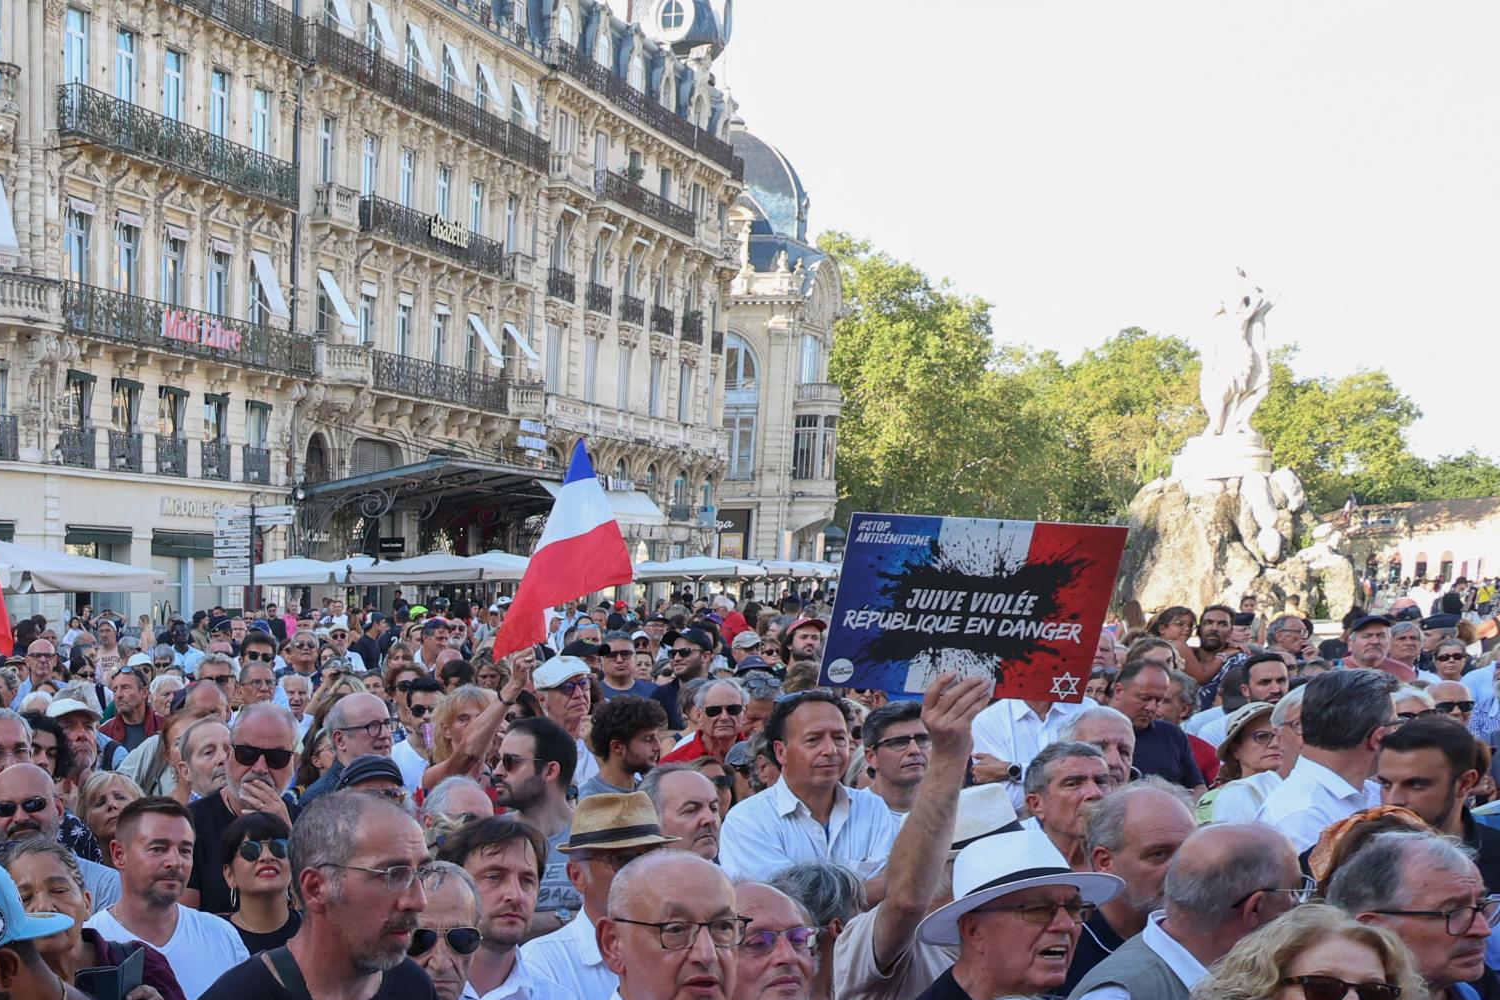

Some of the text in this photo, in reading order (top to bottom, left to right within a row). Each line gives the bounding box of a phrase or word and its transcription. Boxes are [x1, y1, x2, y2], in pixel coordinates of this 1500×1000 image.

[160, 307, 243, 352] Midi Libre
[855, 530, 931, 547] ANTISÉMITISME
[858, 520, 891, 532] #STOP
[905, 588, 1039, 616] JUIVE VIOLÉE
[843, 605, 1083, 644] RÉPUBLIQUE EN DANGER
